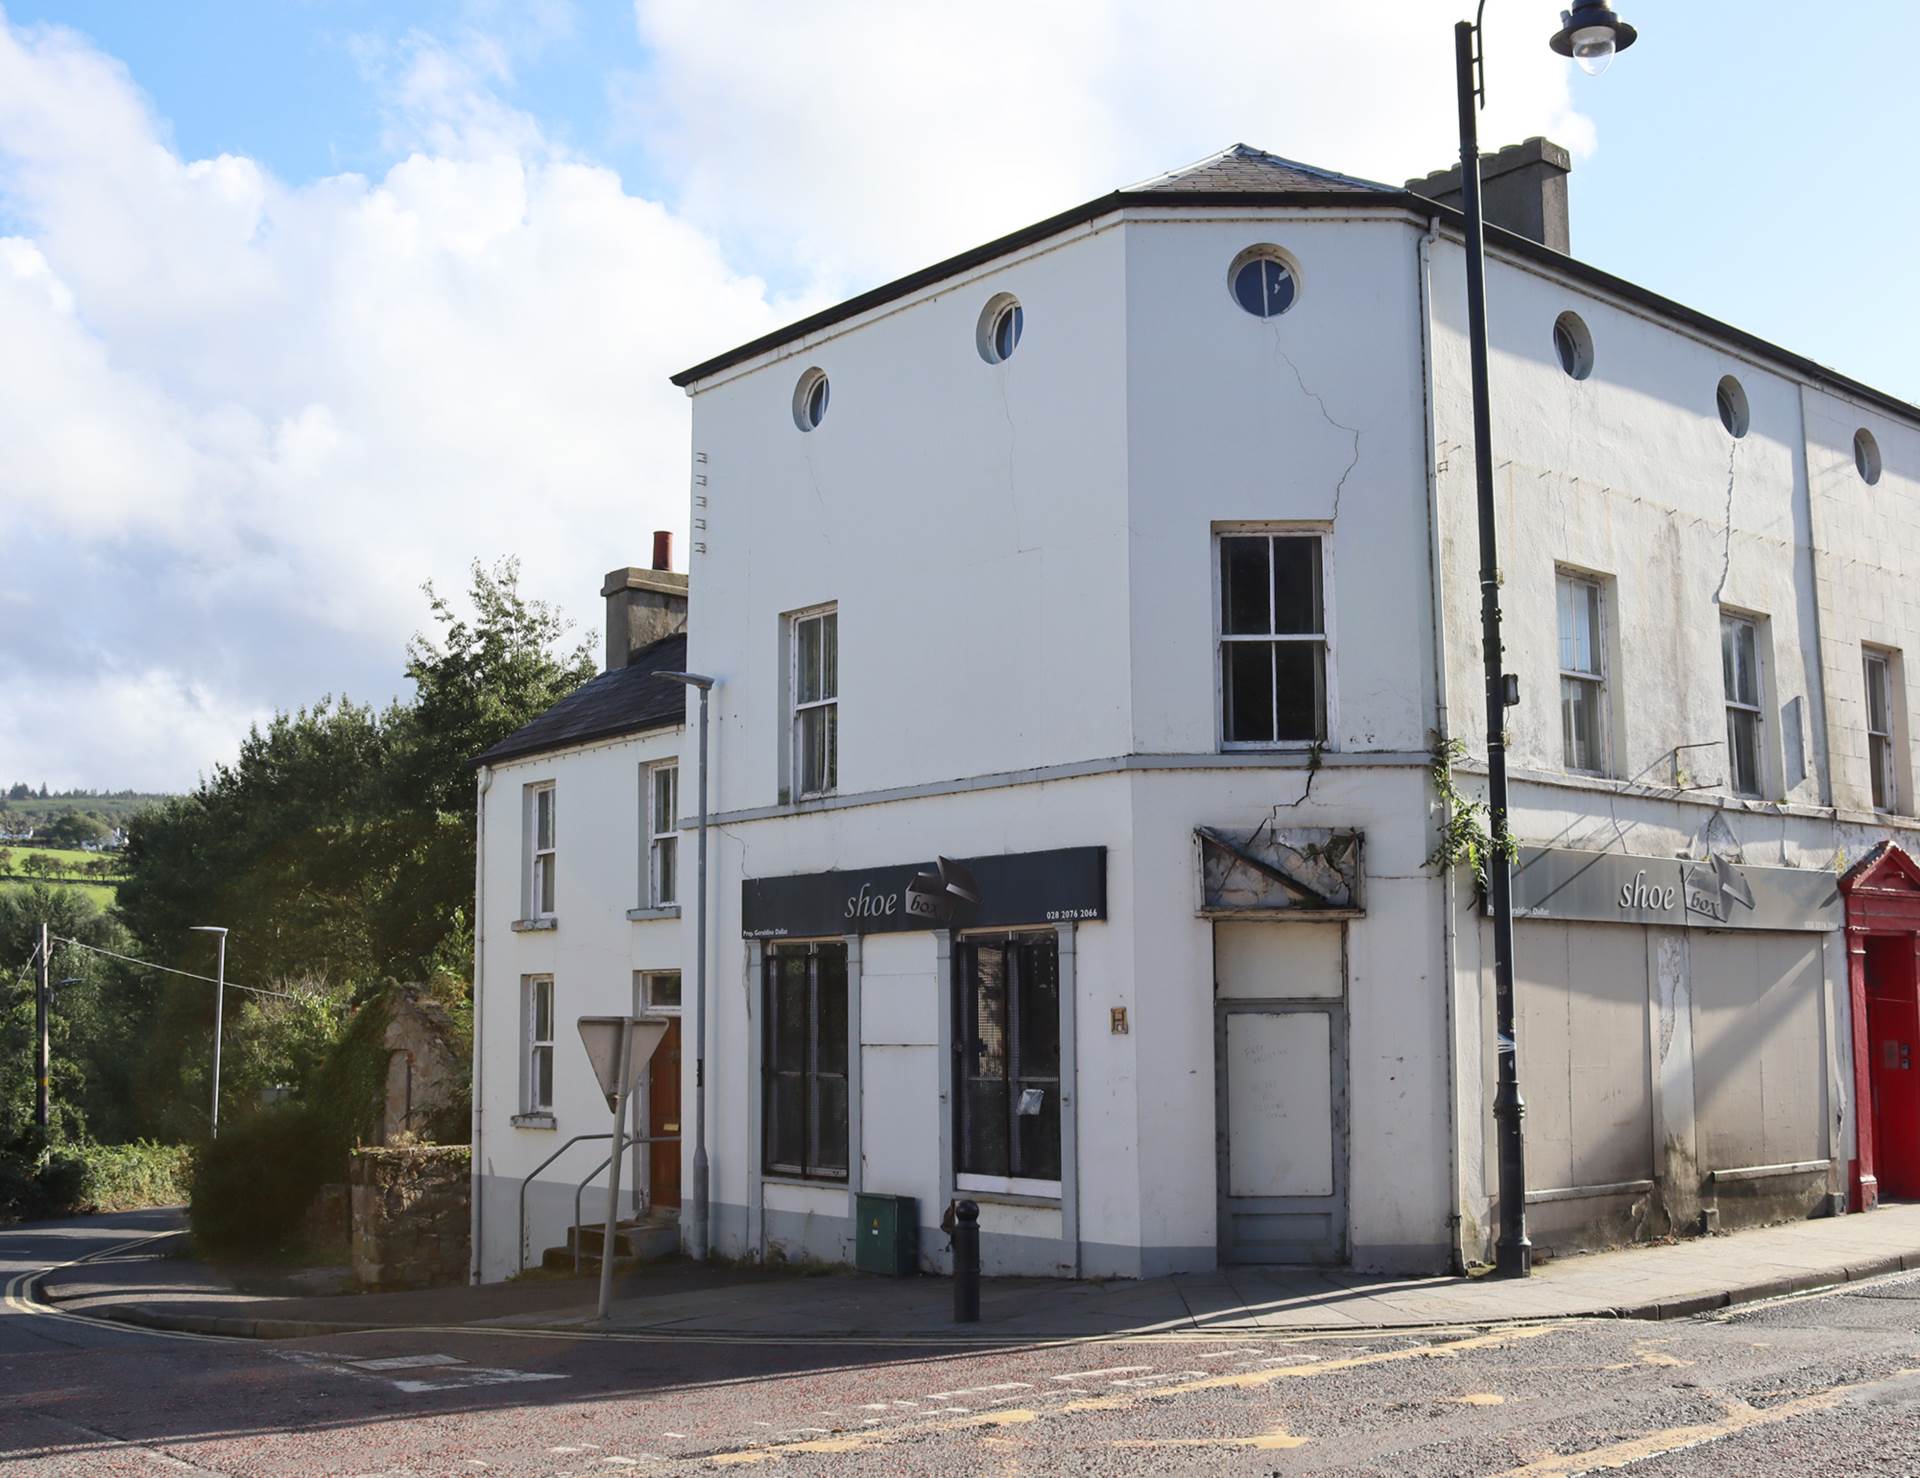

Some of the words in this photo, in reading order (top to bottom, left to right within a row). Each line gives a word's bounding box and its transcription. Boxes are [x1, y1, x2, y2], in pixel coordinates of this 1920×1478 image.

[844, 883, 897, 918] shoe
[1618, 870, 1675, 910] shoe
[1691, 891, 1719, 919] box
[1046, 911, 1060, 920] 028
[1061, 910, 1078, 919] 2076
[1080, 908, 1098, 918] 2066
